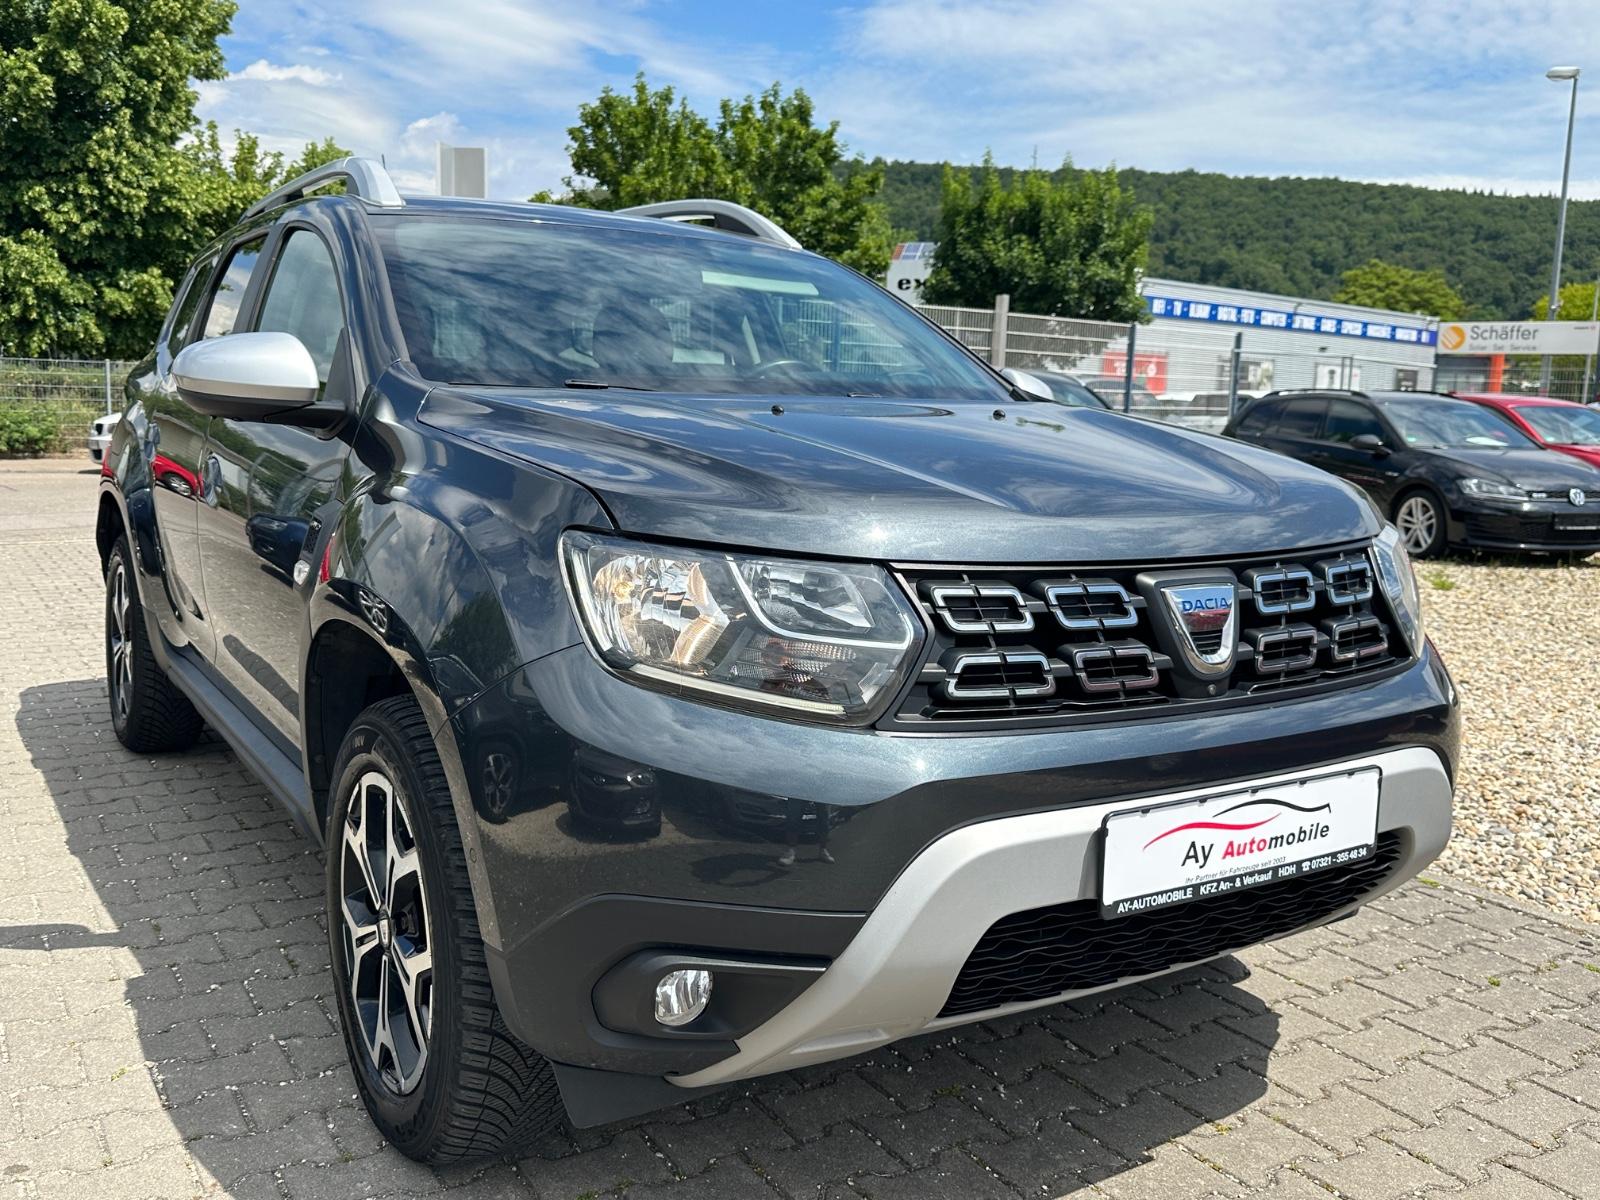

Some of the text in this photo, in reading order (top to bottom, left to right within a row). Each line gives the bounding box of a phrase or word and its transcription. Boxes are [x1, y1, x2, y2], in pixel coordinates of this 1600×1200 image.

[1470, 325, 1539, 340] Schäffer
[1182, 597, 1229, 611] DACIA
[1181, 822, 1330, 869] Ay Automobile
[1195, 871, 1218, 882] Partner
[1219, 869, 1228, 878] für
[1229, 864, 1260, 875] Fahrzeuge
[1261, 860, 1272, 869] seit
[1117, 887, 1193, 914] AY-AUTOMOBILE
[1200, 882, 1218, 895] KFZ
[1218, 879, 1234, 892] An-
[1235, 877, 1241, 887] &
[1243, 870, 1273, 885] Verkauf
[1278, 864, 1297, 877] HDH
[1311, 855, 1332, 870] 07321
